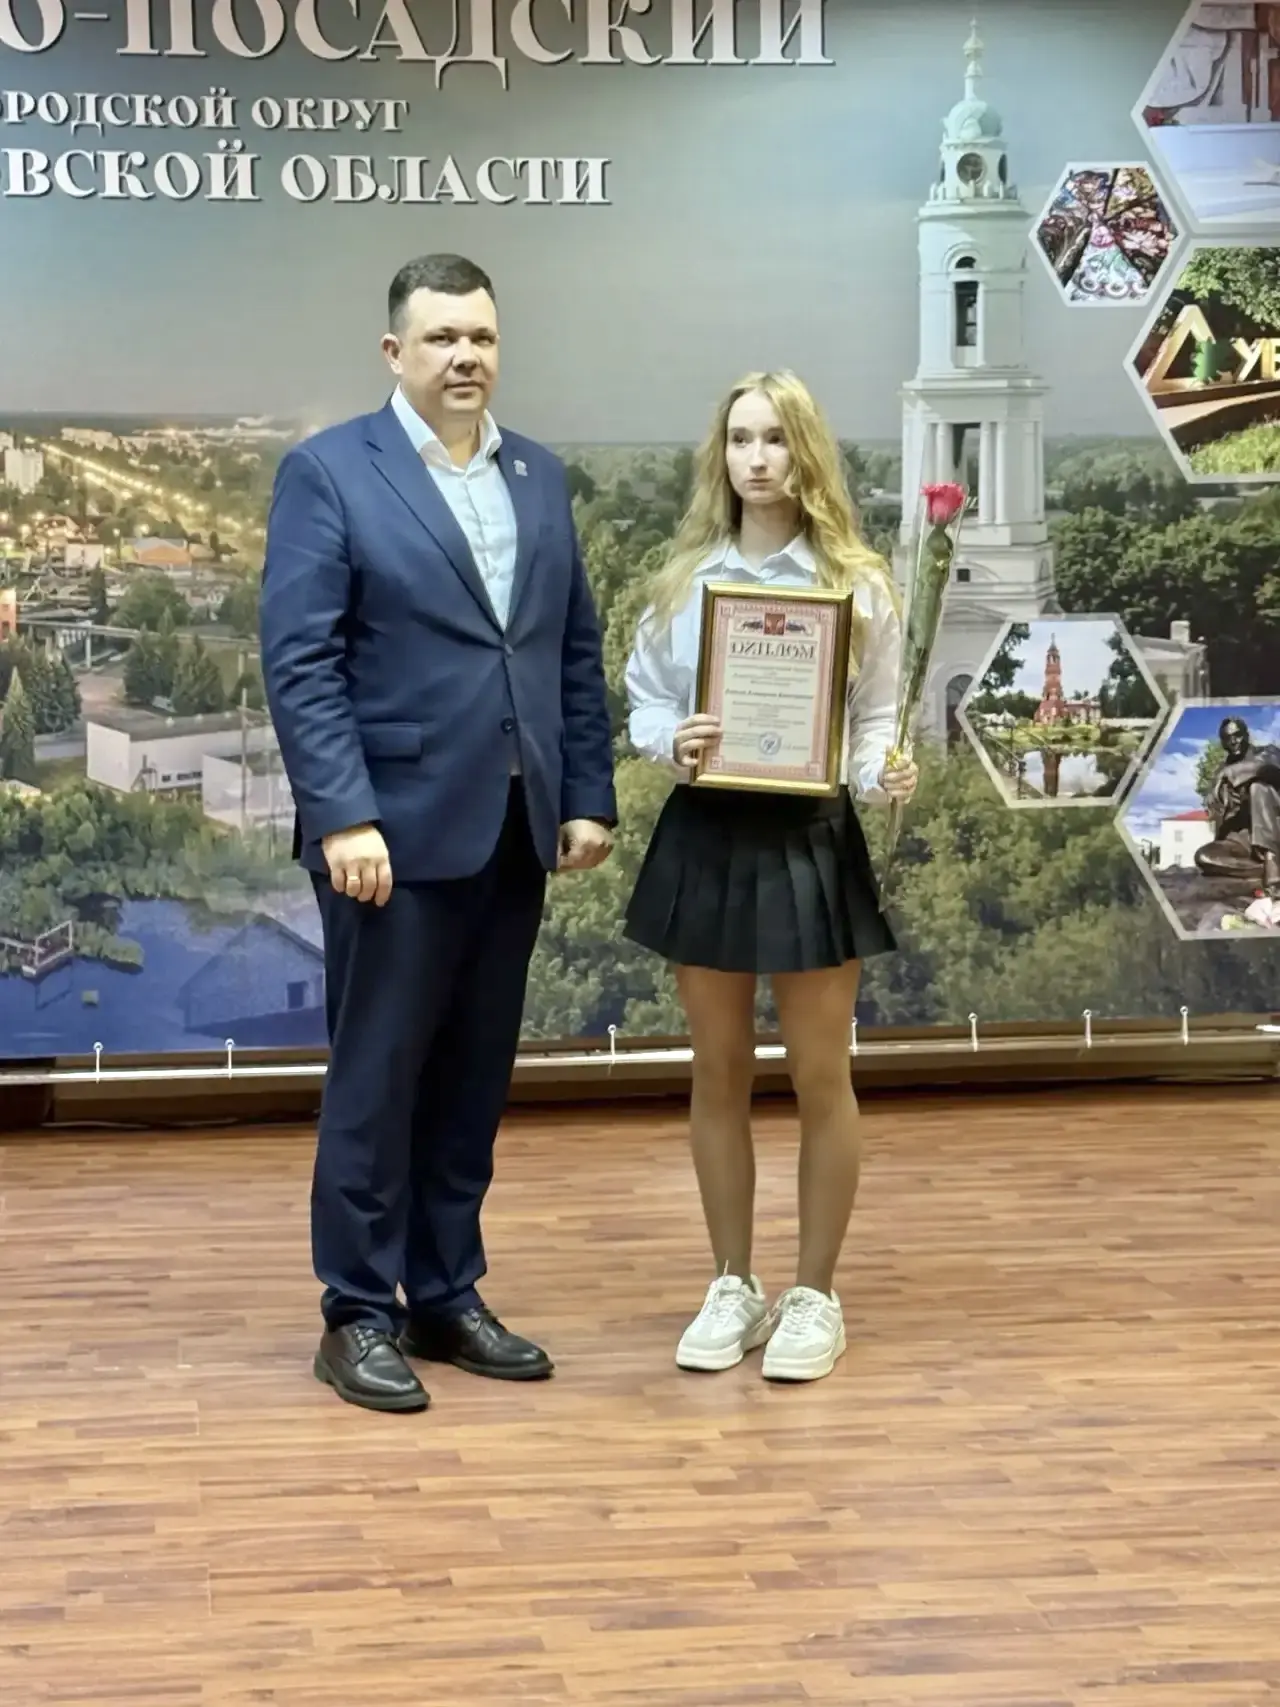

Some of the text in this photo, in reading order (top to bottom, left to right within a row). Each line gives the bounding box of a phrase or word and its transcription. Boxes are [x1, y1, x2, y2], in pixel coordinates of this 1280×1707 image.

[2, 87, 408, 135] РОДСКОЙ ОКРУГ
[1, 139, 612, 204] ВСКОЙ ОБЛАСТИ
[731, 641, 814, 659] ДИПЛОМ
